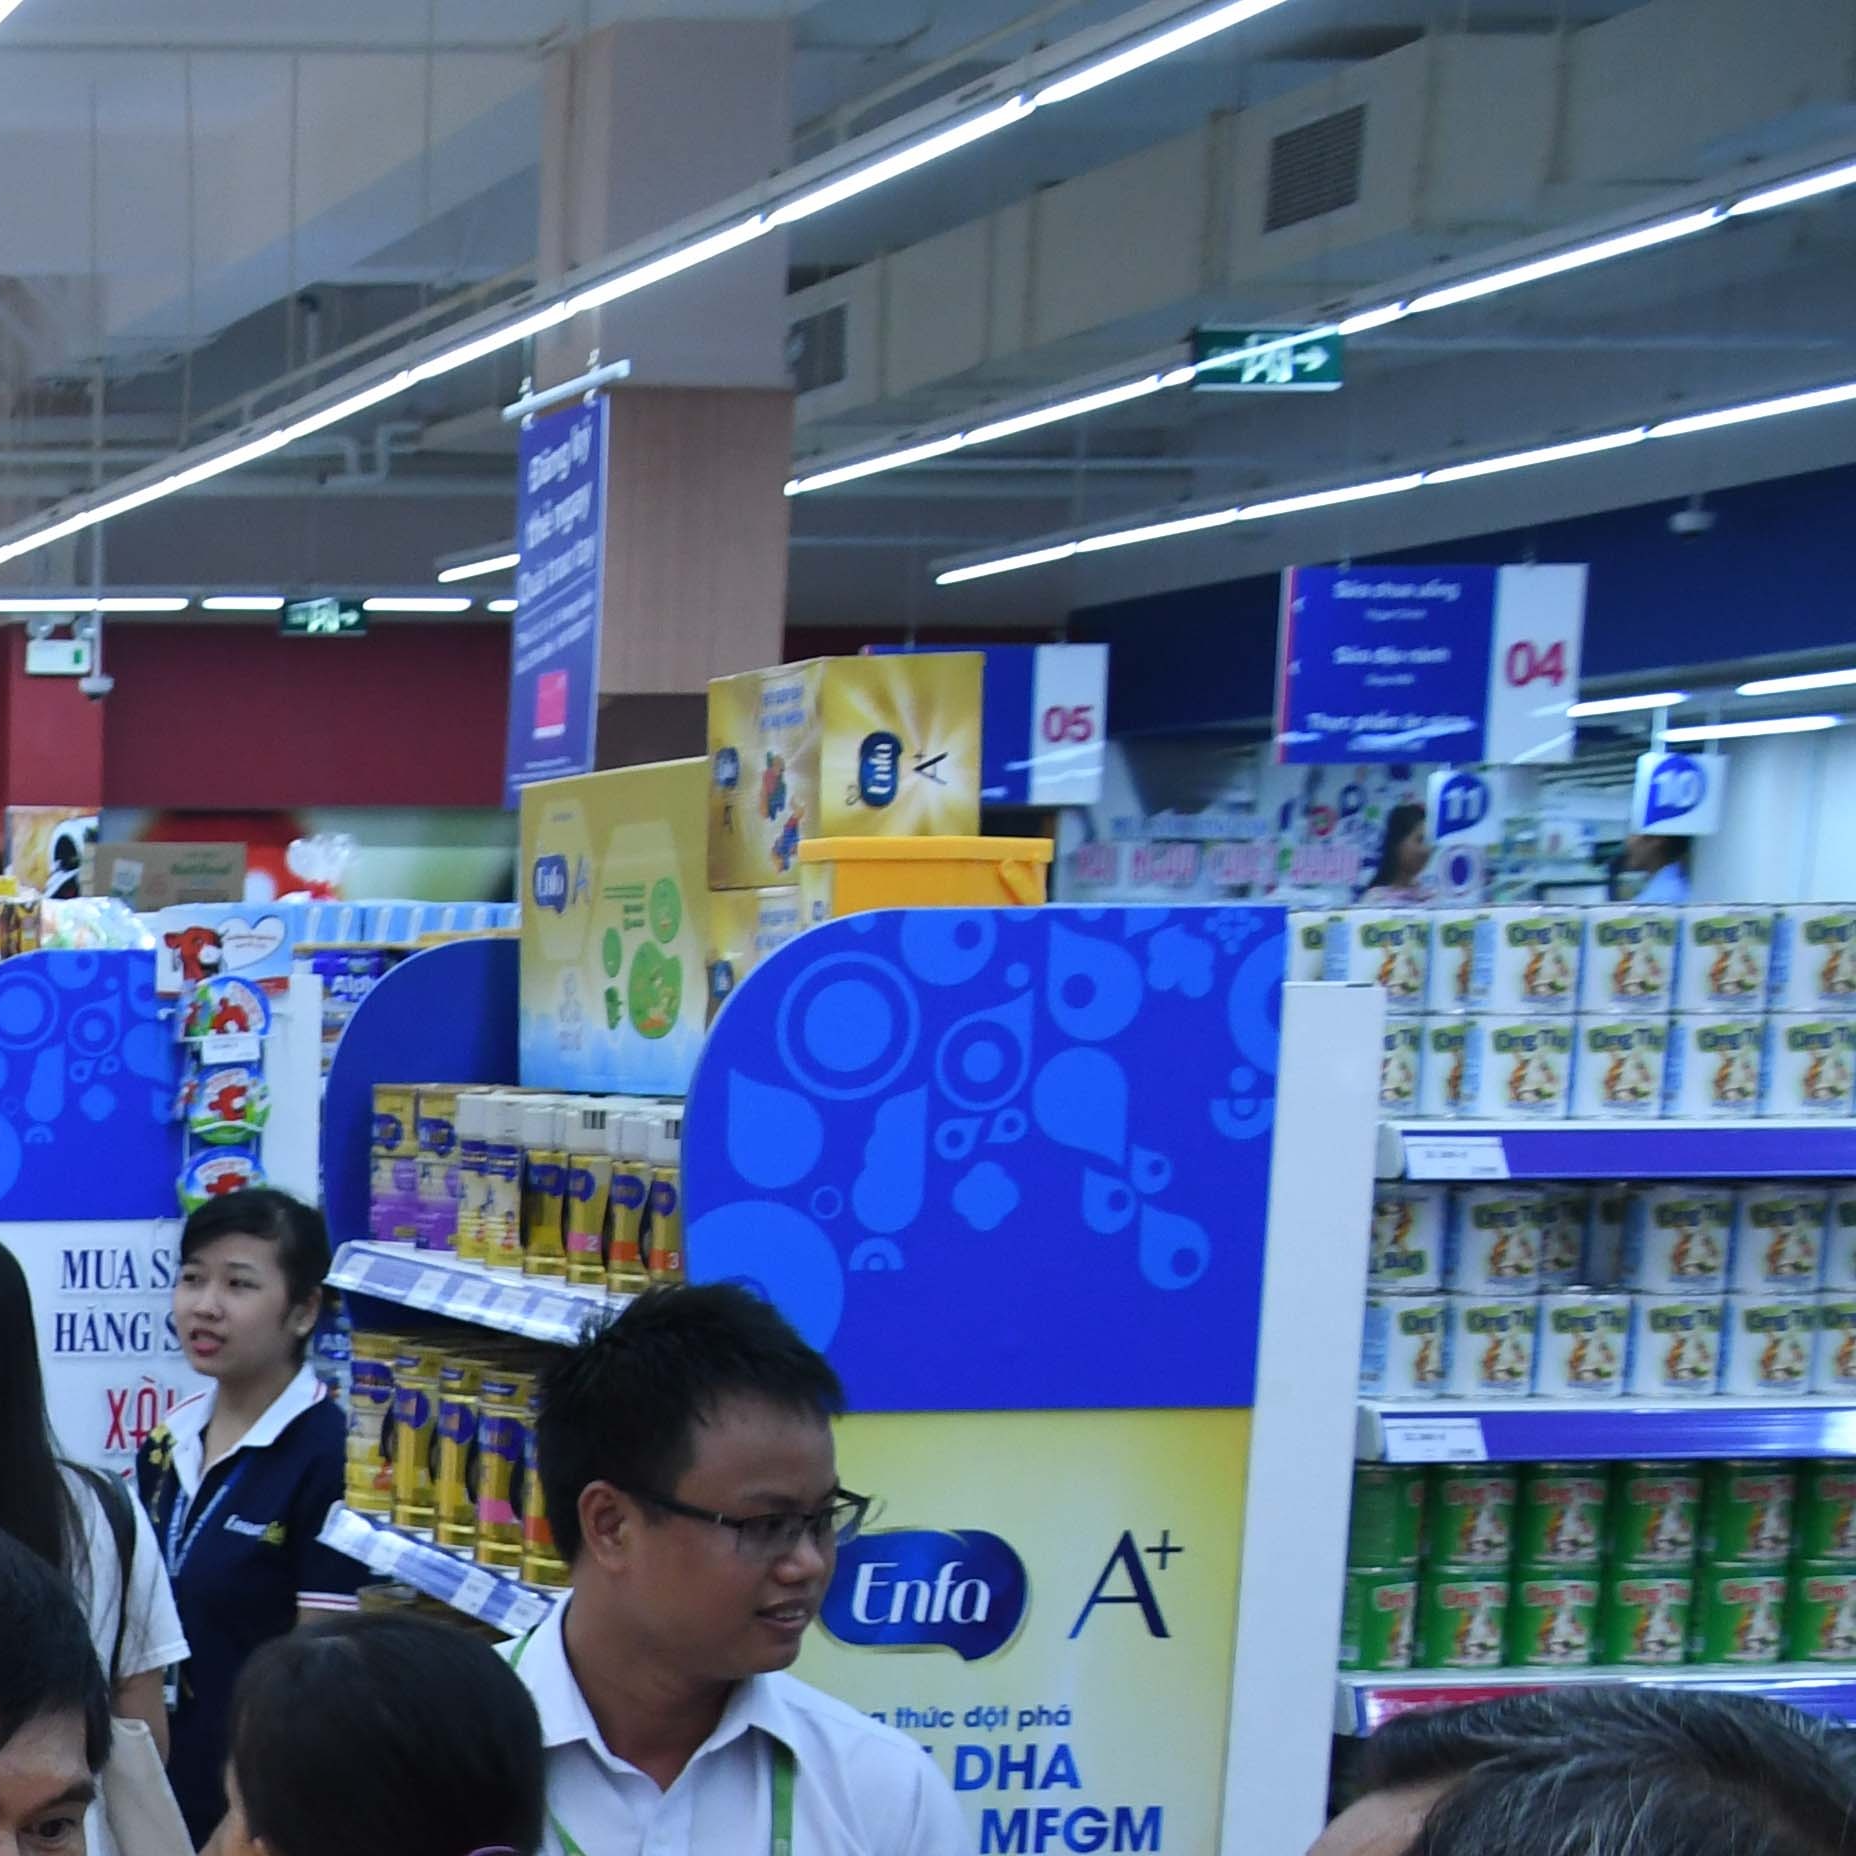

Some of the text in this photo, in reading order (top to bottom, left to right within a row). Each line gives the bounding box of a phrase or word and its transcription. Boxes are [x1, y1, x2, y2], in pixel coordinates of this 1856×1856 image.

[1506, 641, 1566, 687] 04
[1043, 705, 1096, 744] 05
[60, 1249, 140, 1290] MUA
[850, 1562, 992, 1626] Enfa
[895, 1703, 1072, 1734] thức đột phá
[953, 1744, 1082, 1792] DHA
[979, 1805, 1164, 1856] MFGM
